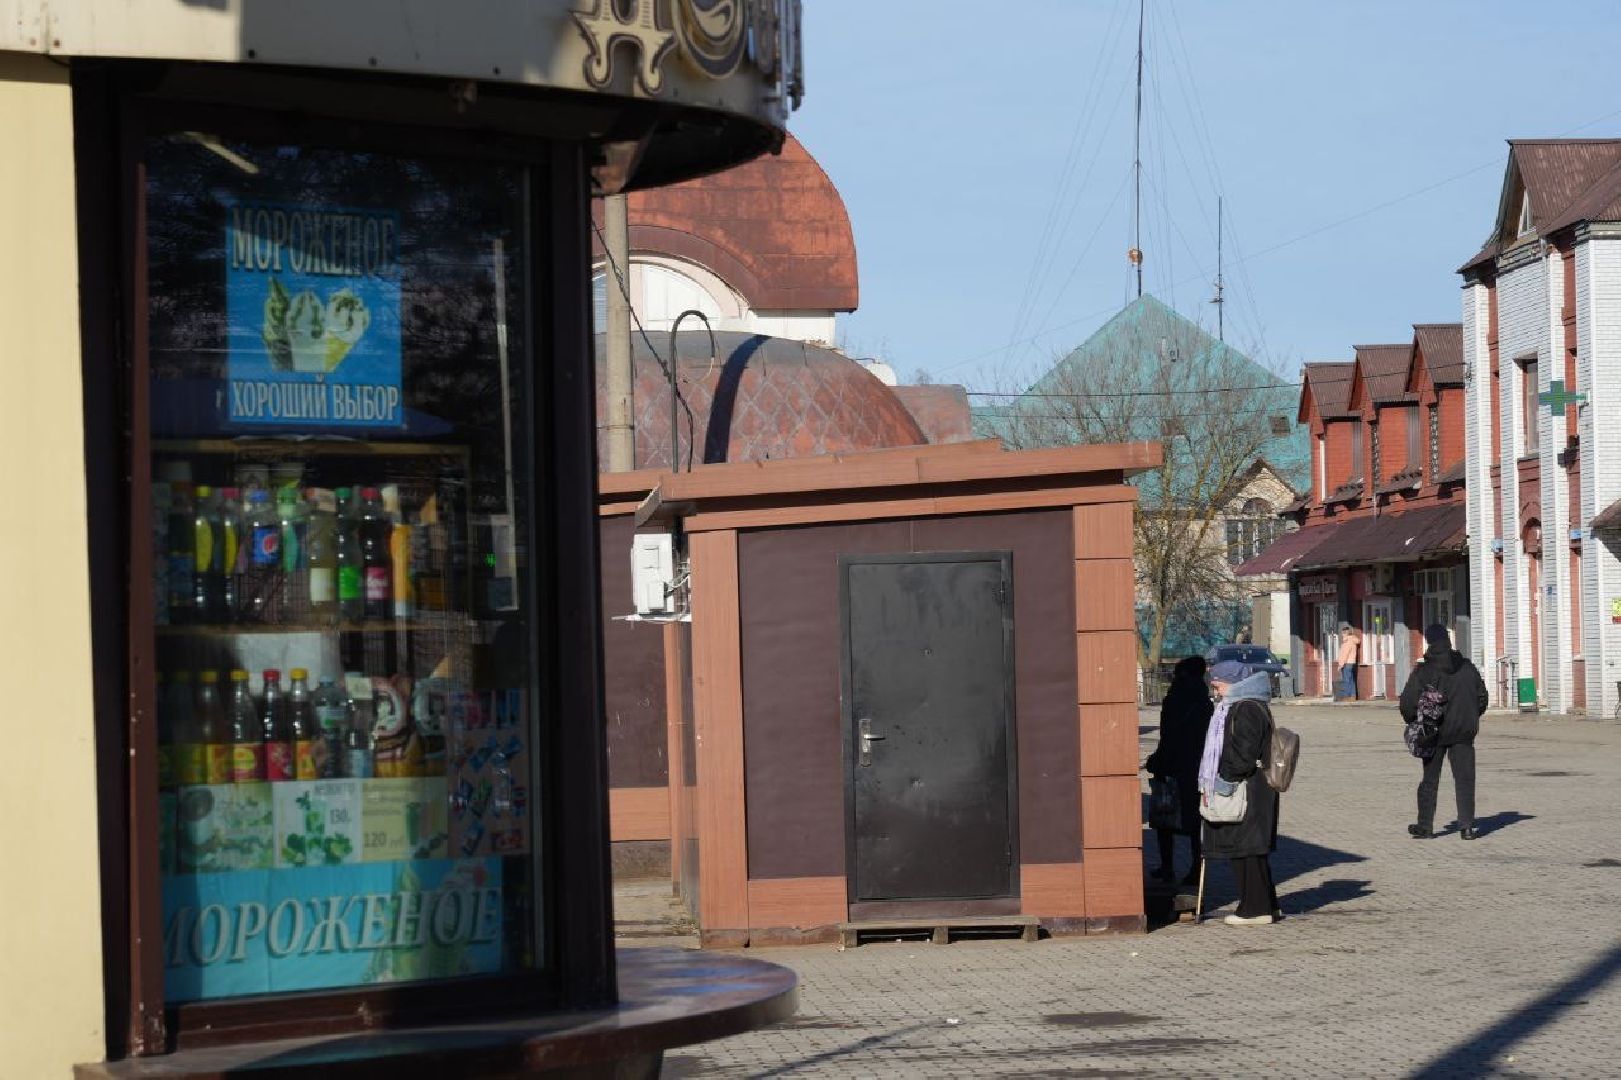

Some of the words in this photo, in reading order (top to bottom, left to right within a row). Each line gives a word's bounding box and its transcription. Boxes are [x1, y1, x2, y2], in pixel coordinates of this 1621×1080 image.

[232, 208, 396, 275] МОРОЖЕНОЕ
[232, 374, 327, 418] ХОРОШИЙ
[333, 384, 398, 421] ВЫБОР
